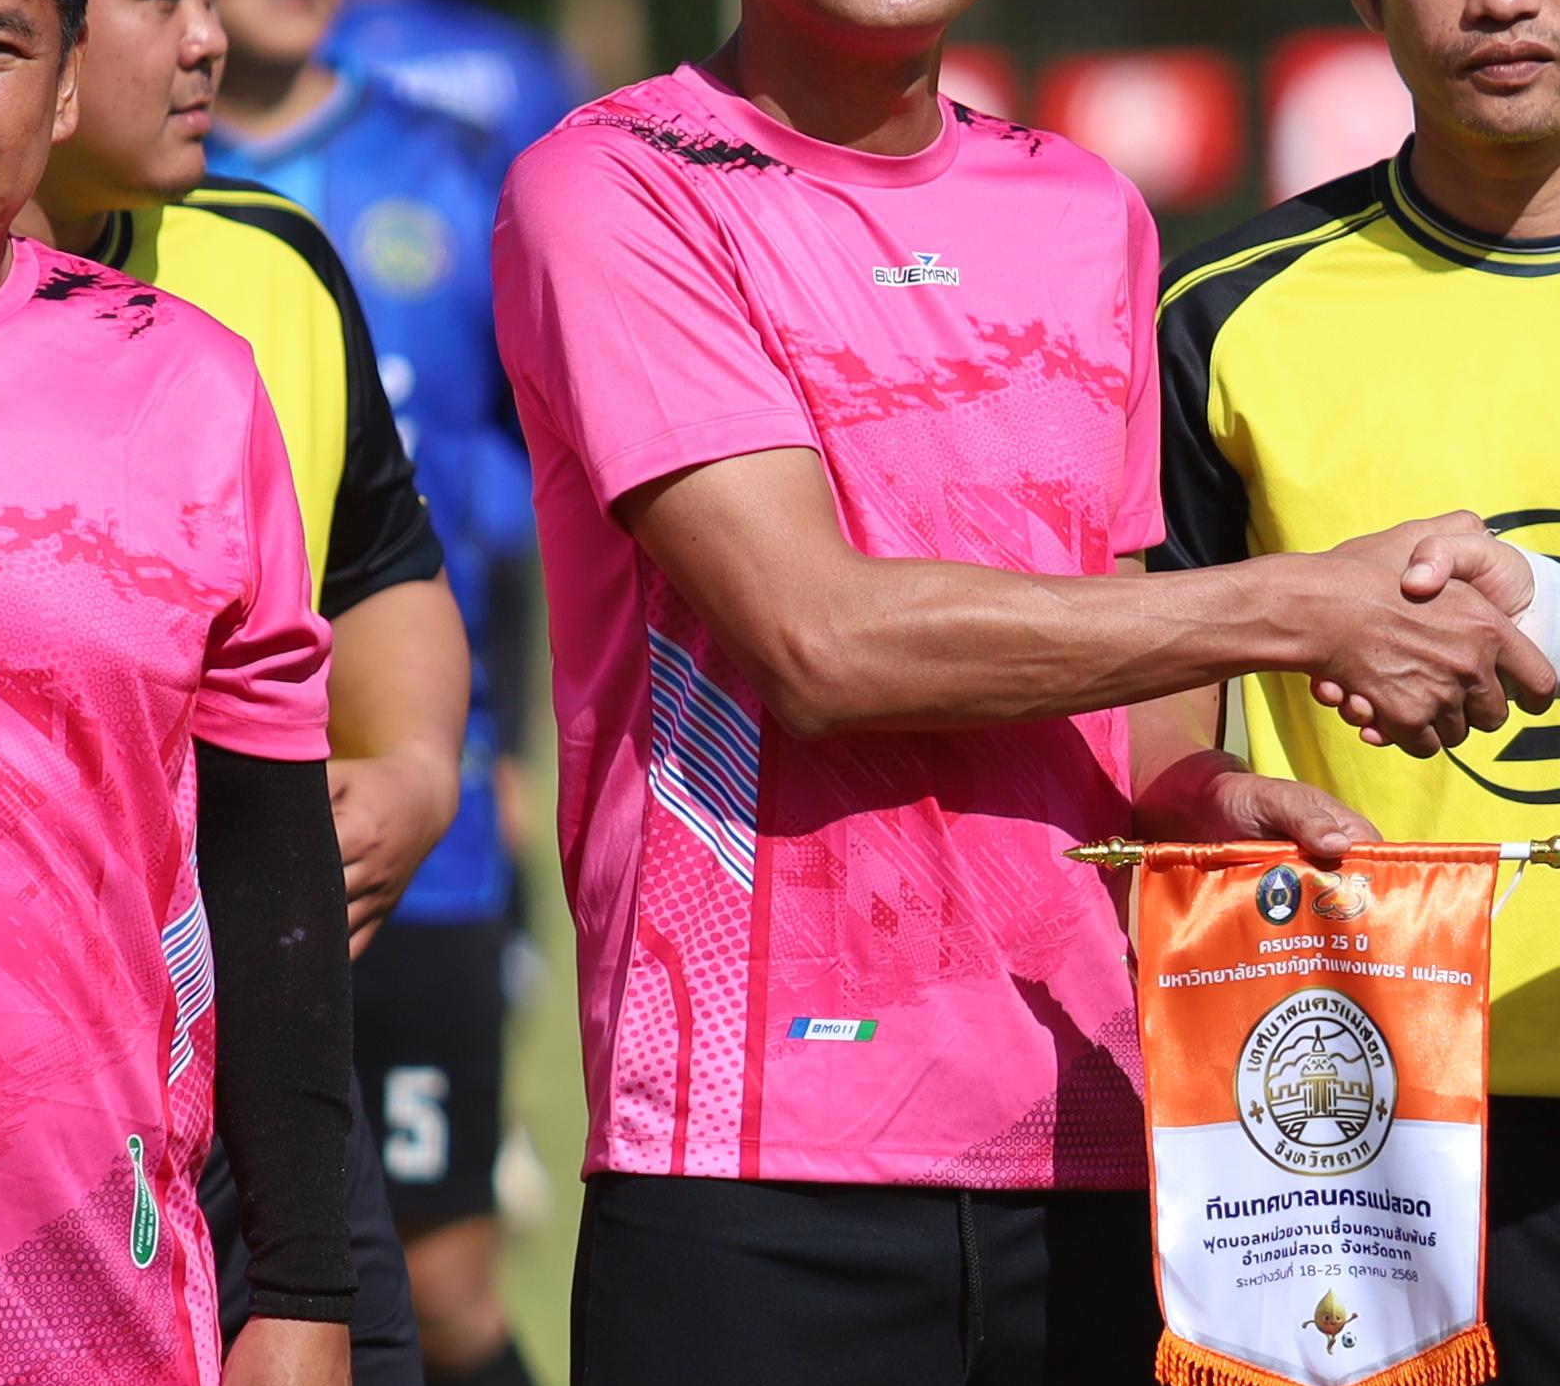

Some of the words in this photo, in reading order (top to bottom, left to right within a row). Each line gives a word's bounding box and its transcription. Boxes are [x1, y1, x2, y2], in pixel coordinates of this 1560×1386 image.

[874, 267, 958, 285] BLUEMAN
[1259, 935, 1325, 954] ครบรอบ
[1330, 934, 1349, 951] 25
[1354, 932, 1369, 952] ปี
[1158, 952, 1406, 988] มหาวิทยาลัยราชภัฏกำแพงเพชร
[1412, 963, 1473, 987] แม่สอด
[811, 1023, 854, 1034] BM011
[1245, 996, 1386, 1073] เทศบาลนครแม่สอด
[383, 1065, 451, 1184] 5
[1273, 1139, 1372, 1168] จังหวัดตาก
[1205, 1188, 1432, 1221] ทีมเทศบาลนครแม่สอด
[1203, 1216, 1438, 1254] ฟุตบอลหน่วยงานเชื่อมความสัมพันธ์
[1242, 1242, 1333, 1266] อำเภอแม่สอด
[1341, 1239, 1412, 1262] จังหวัดตาก
[1236, 1261, 1294, 1288] ระหว่างวันที่
[1299, 1264, 1342, 1278] 18-25
[1348, 1264, 1387, 1280] ตุลาคม
[1391, 1268, 1420, 1283] 2568
